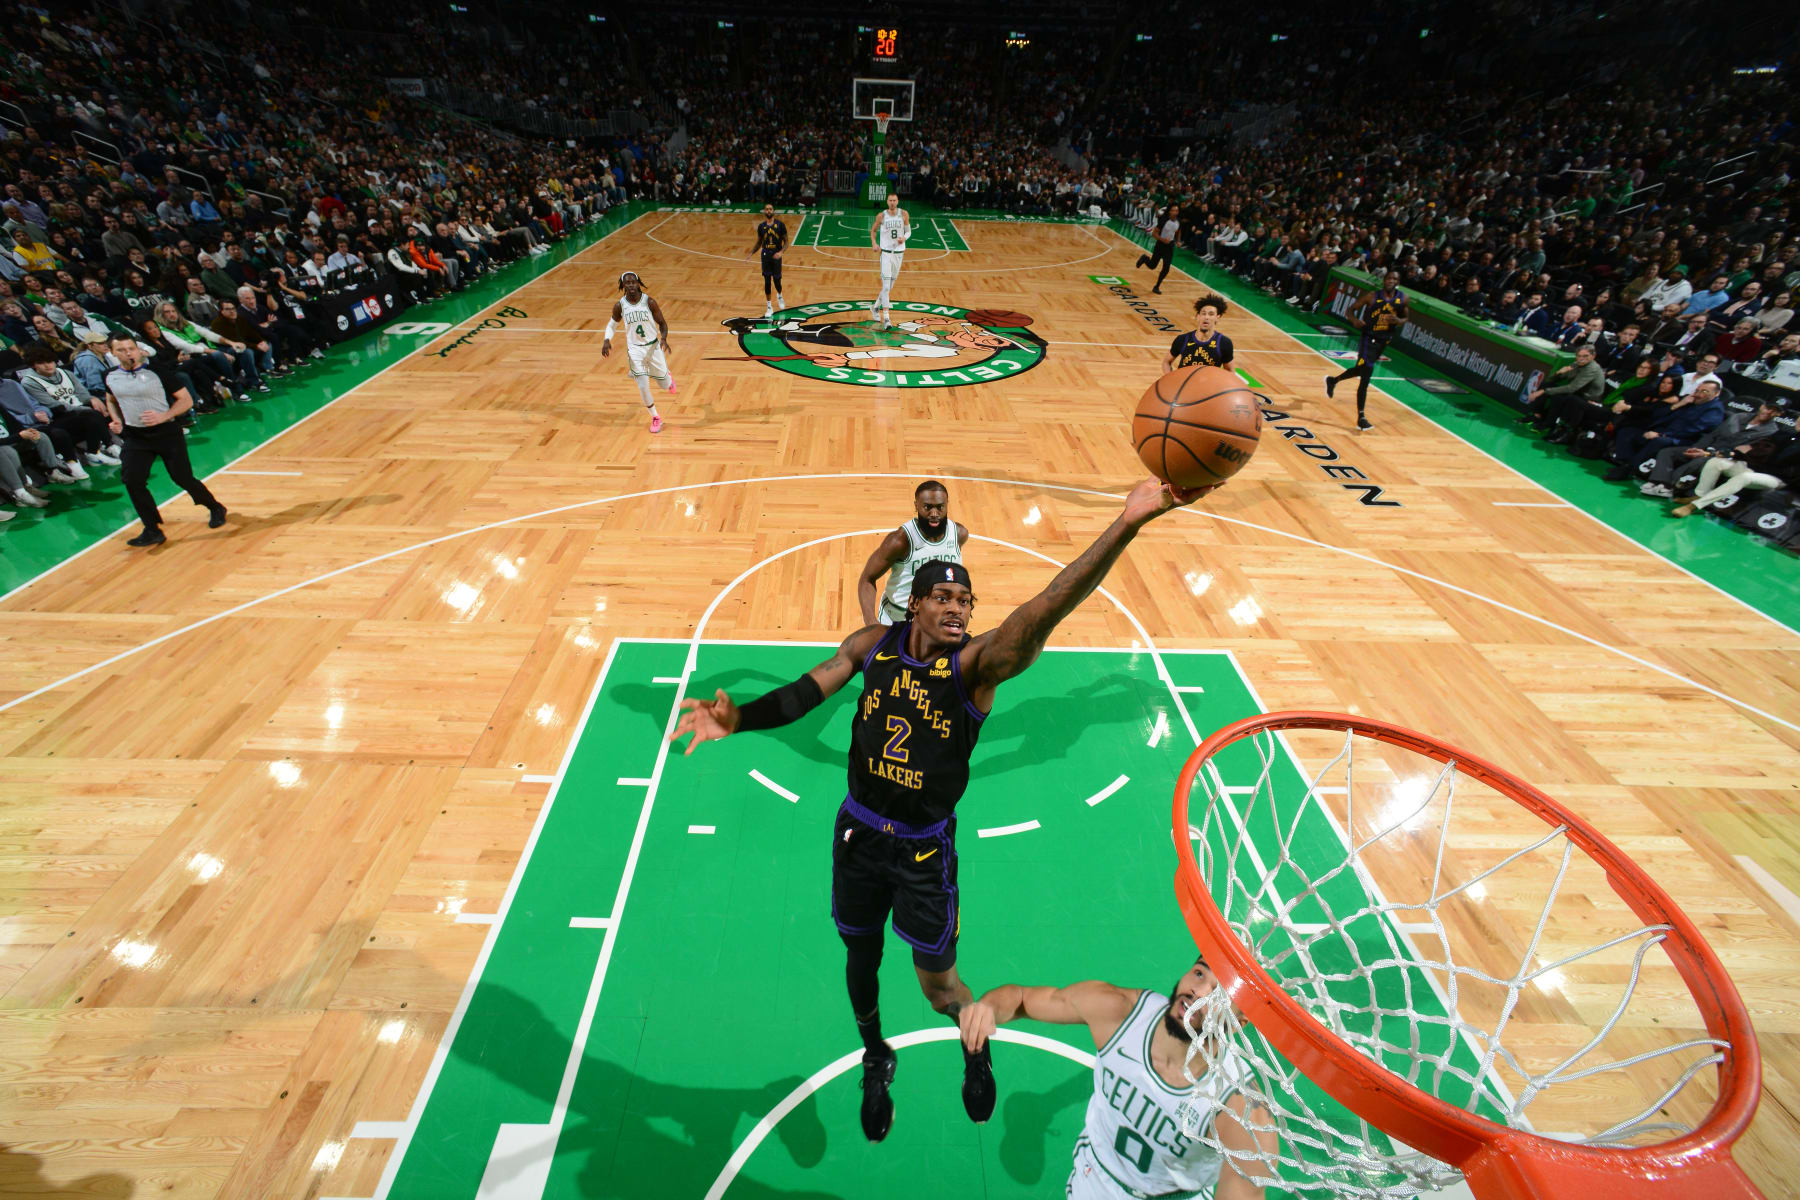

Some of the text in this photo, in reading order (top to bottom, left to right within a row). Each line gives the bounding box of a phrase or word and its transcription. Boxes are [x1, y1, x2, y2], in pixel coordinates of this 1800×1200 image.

[876, 39, 895, 56] 20
[891, 229, 898, 239] 8
[624, 310, 650, 324] CELTICS
[1108, 285, 1183, 333] GARDEN
[635, 324, 646, 337] 4
[825, 358, 1023, 386] CELTICS
[1400, 320, 1525, 392] NBA Celebrates Black History Month
[929, 668, 952, 678] bibigo
[889, 668, 952, 738] ANGELES
[882, 713, 913, 764] 2
[868, 757, 924, 790] LAKERS
[1102, 1066, 1192, 1159] CELTICS
[1114, 1125, 1155, 1174] 0
